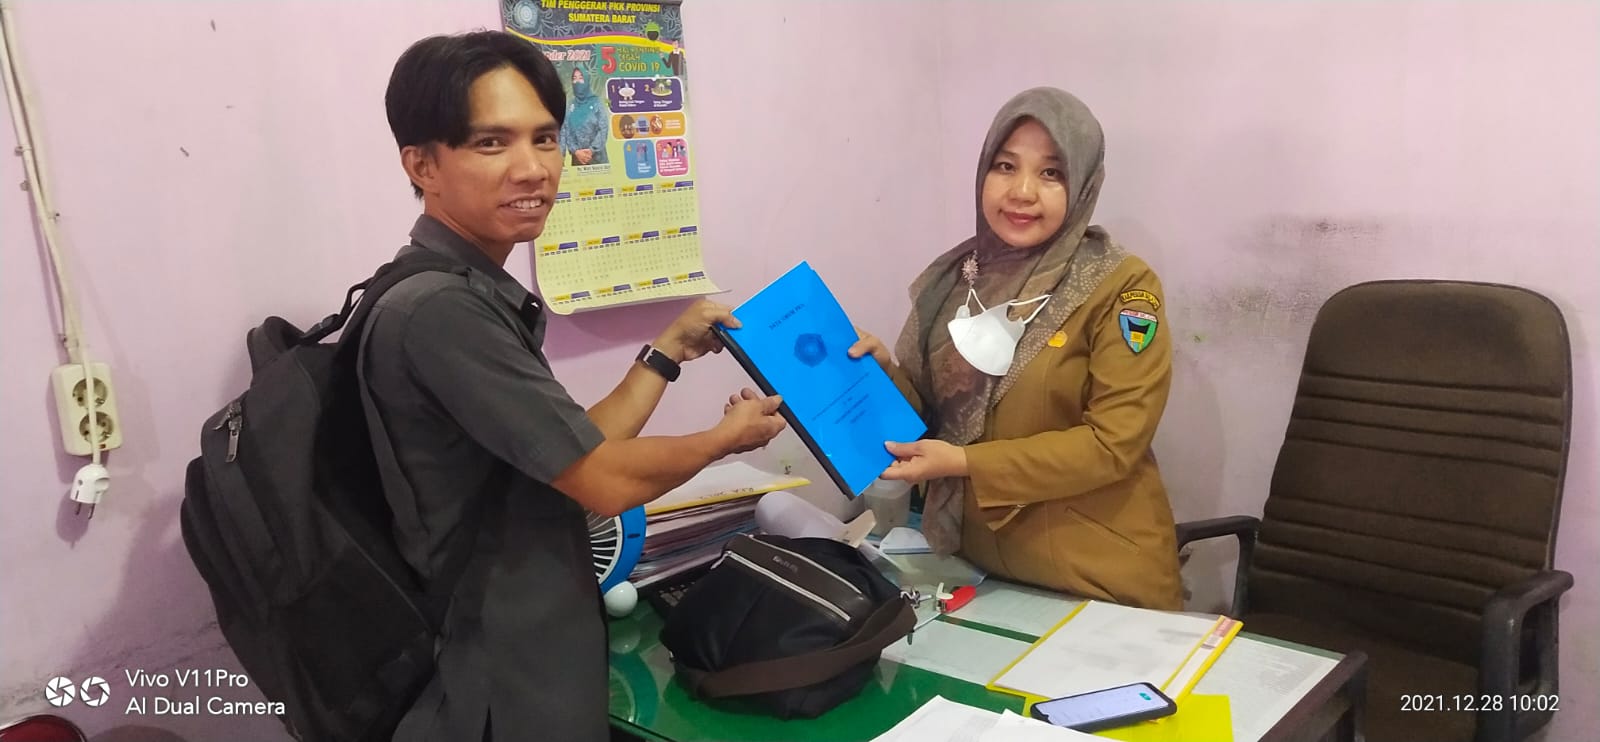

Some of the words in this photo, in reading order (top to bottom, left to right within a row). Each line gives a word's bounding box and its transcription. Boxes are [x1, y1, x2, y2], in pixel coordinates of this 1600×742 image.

[541, 0, 556, 9] TIM
[558, 0, 607, 11] PENGGERAK
[609, 2, 624, 11] PKK
[626, 3, 660, 13] PROVINSI
[568, 12, 610, 23] SUMATERA
[611, 14, 636, 24] BARAT
[601, 46, 617, 74] 5
[618, 62, 648, 73] COVID
[651, 61, 661, 73] 19
